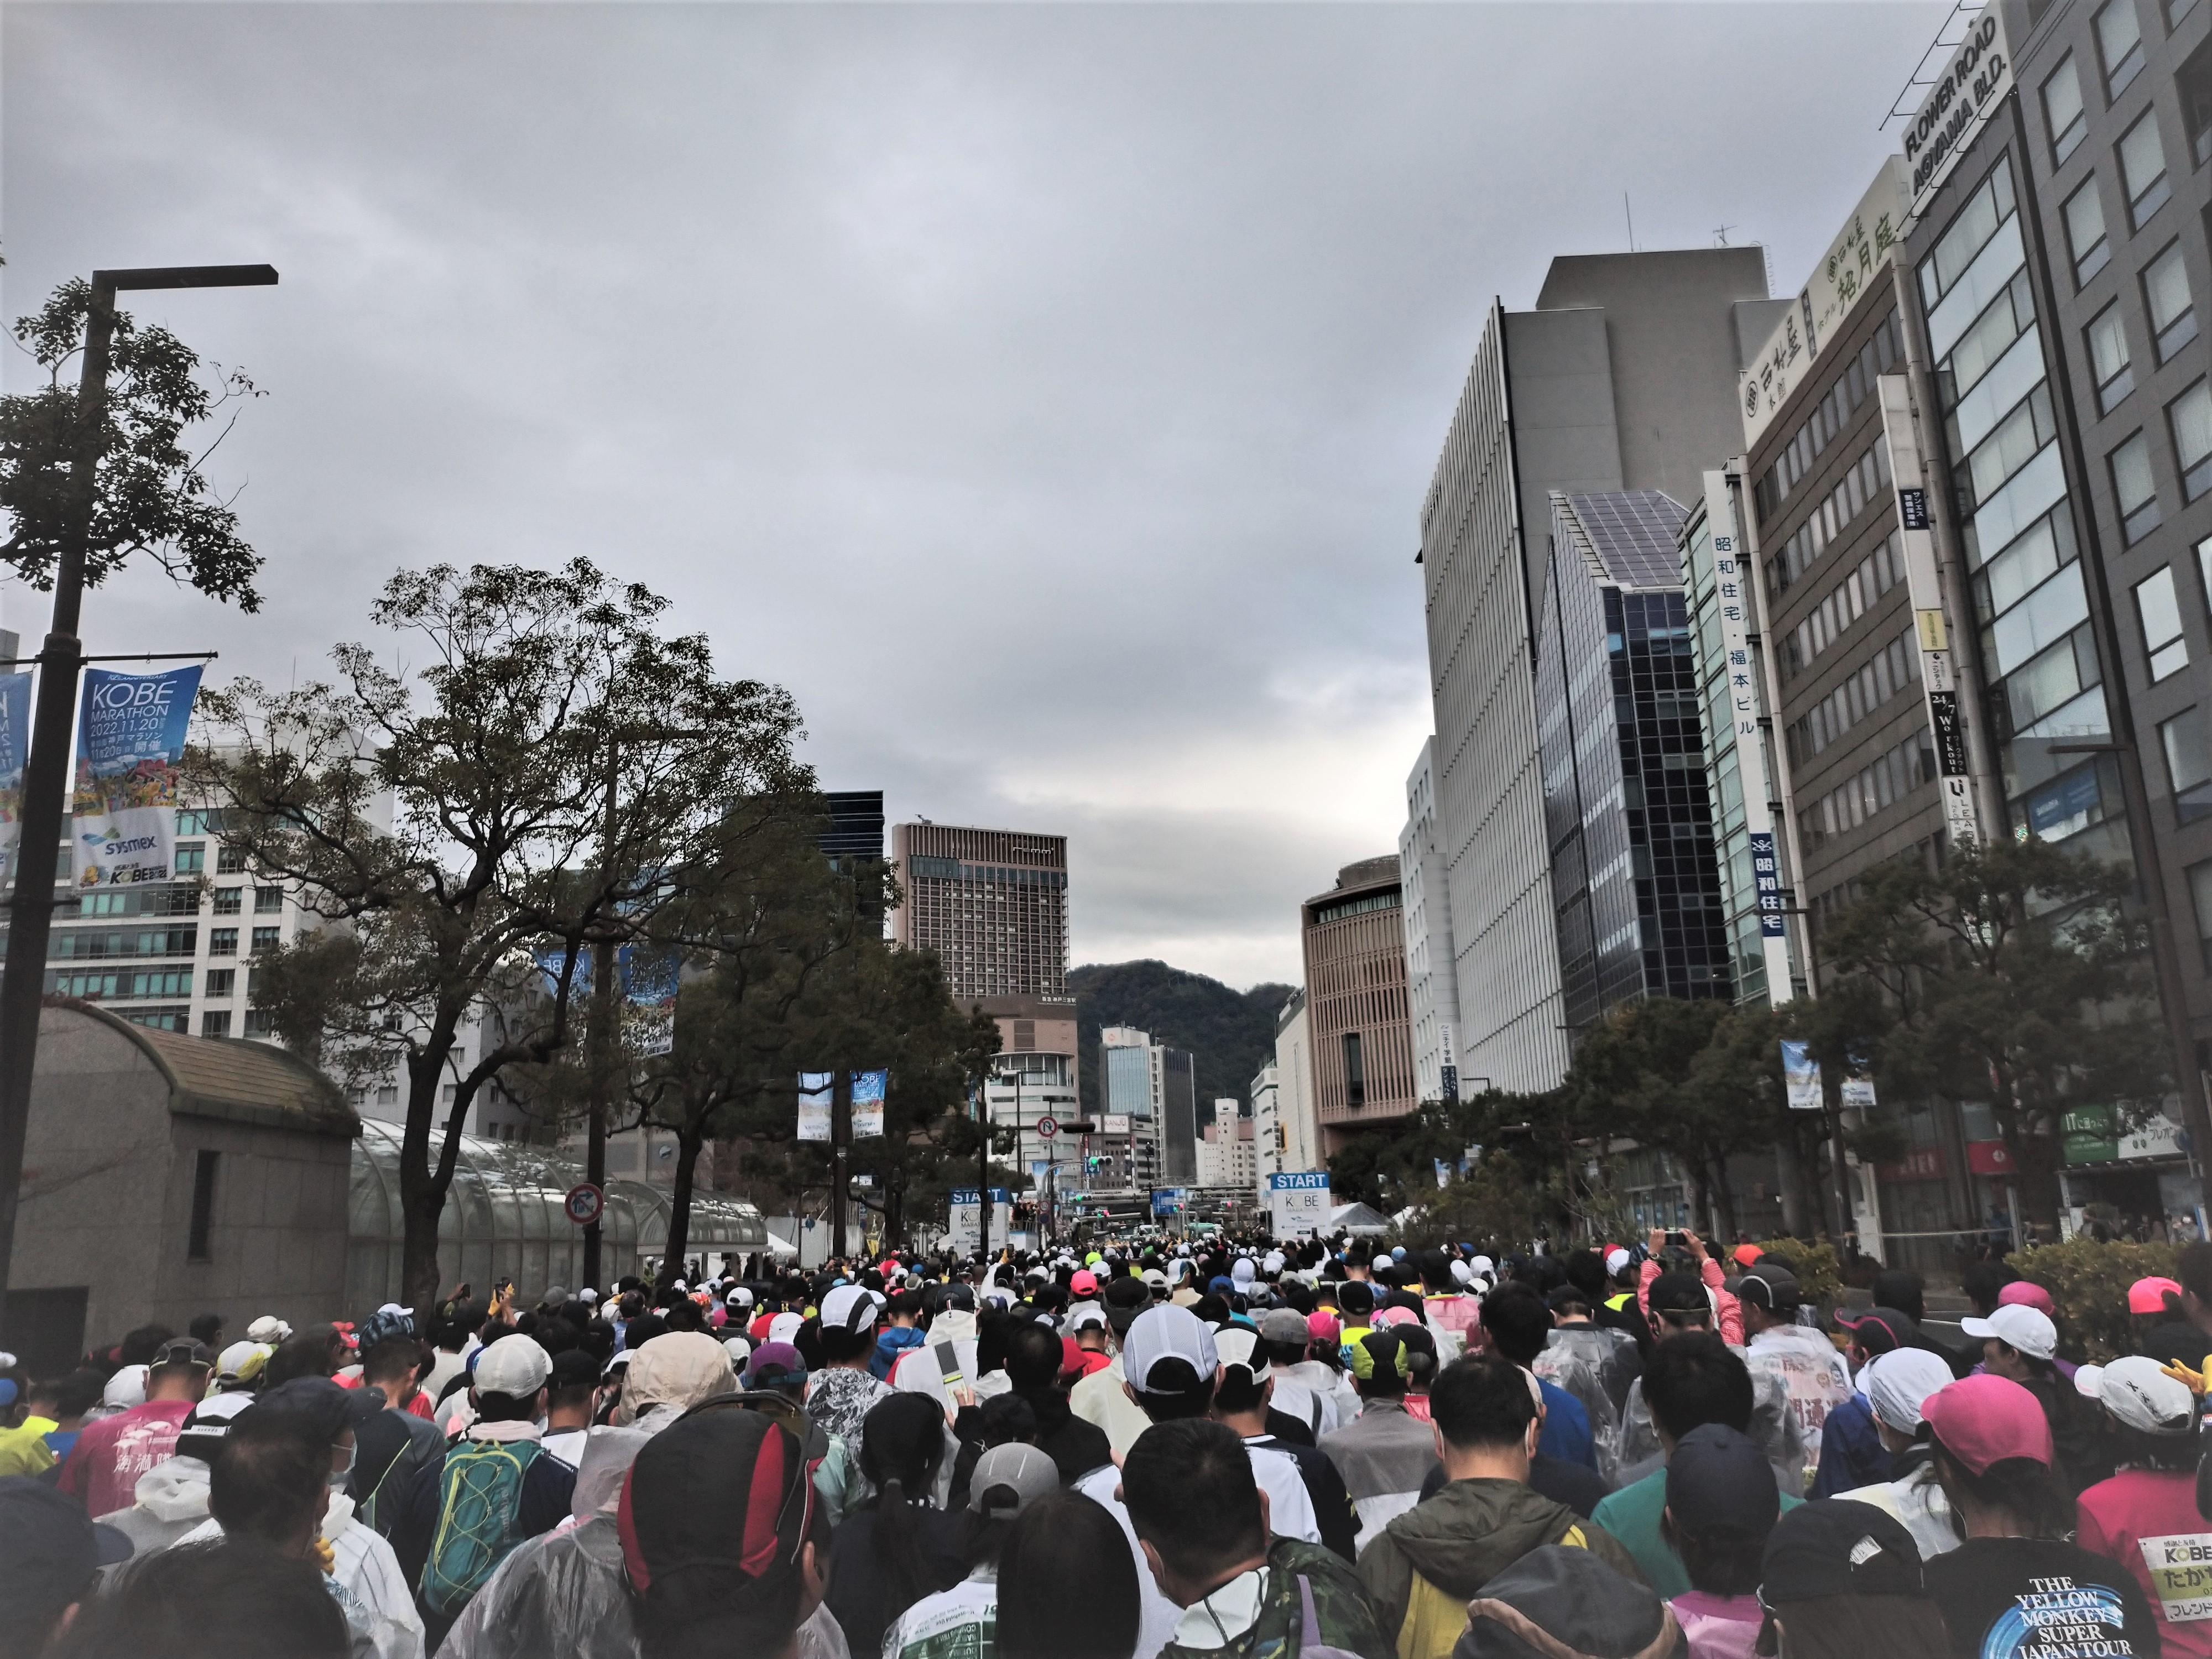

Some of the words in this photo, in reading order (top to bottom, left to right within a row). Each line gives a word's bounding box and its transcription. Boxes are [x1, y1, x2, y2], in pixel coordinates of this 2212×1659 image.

[1905, 76, 1955, 161] FLOWER
[1954, 16, 1995, 87] ROAD
[1973, 54, 2006, 106] BLD.
[1912, 492, 1924, 517] サンエス
[1715, 536, 1754, 734] 昭和住宅・福本ビル
[92, 680, 178, 709] KOBE
[1931, 695, 1955, 714] 24/7
[91, 705, 169, 723] MARATHON
[90, 717, 158, 737] 2022.11.20
[1938, 715, 1956, 774] Workout
[105, 836, 158, 855] sysmex
[109, 867, 148, 884] KOBE
[1755, 858, 1782, 928] 昭和住宅
[1276, 1173, 1325, 1188] START
[953, 1189, 1001, 1203] STAT
[1286, 1195, 1319, 1207] KOBE
[2164, 1545, 2212, 1563] KOBE
[2028, 1577, 2077, 1593] THE
[2014, 1591, 2099, 1610] YELLOW
[2018, 1607, 2109, 1627] MONKEY
[2038, 1624, 2105, 1644] SUPER
[2017, 1642, 2078, 1659] JAPAN
[2078, 1639, 2133, 1658] TOUR
